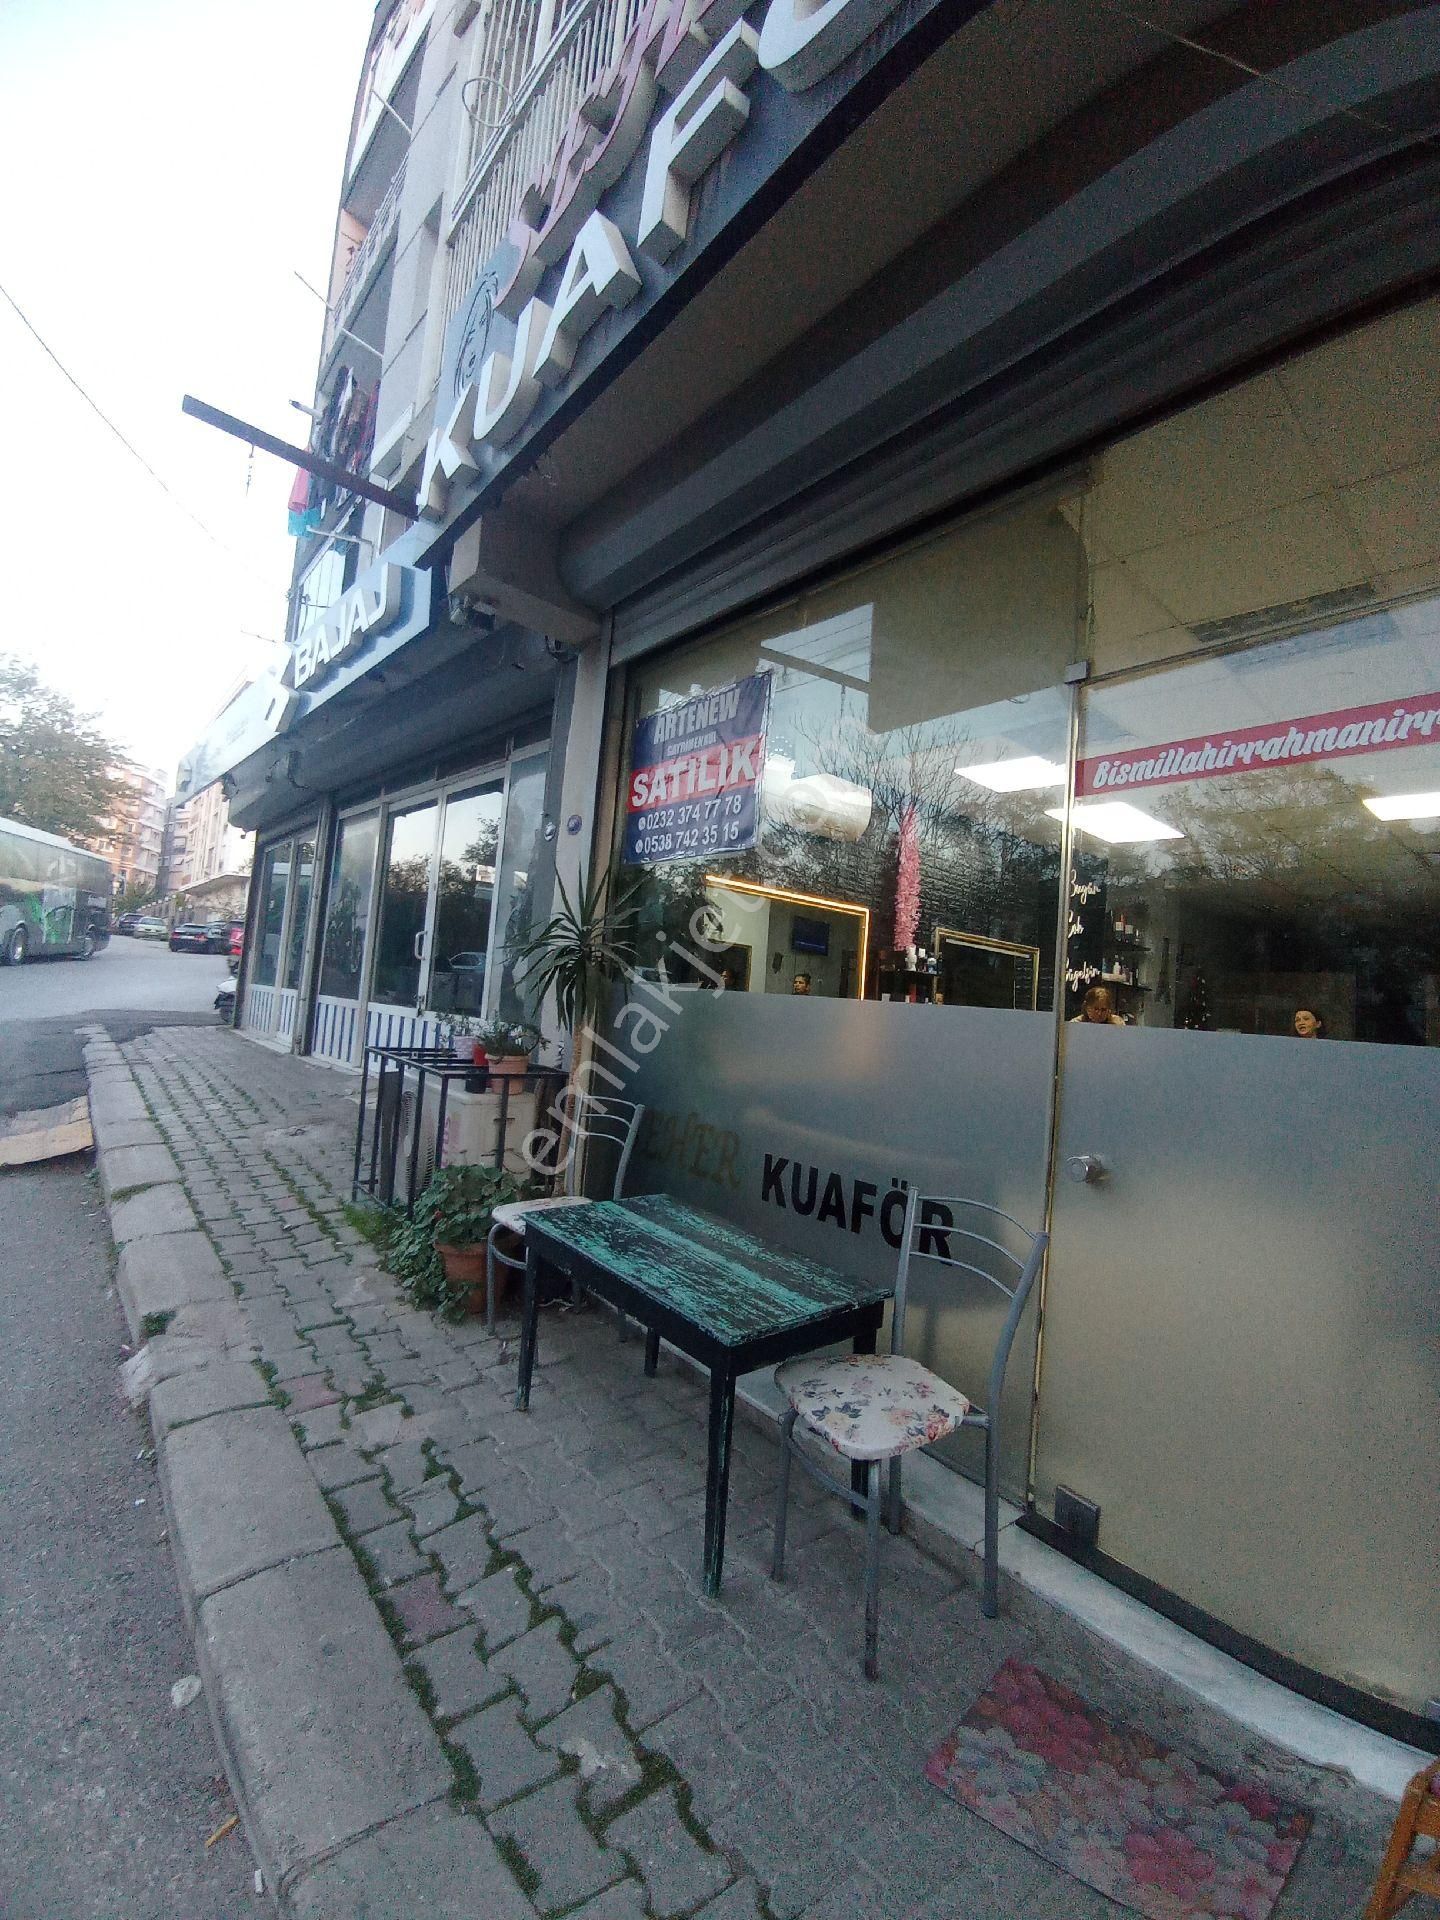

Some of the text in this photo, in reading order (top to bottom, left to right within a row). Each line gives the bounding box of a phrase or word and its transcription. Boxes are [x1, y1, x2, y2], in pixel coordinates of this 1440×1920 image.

[294, 561, 389, 690] BAJAJ
[653, 688, 740, 745] ARTENEW
[644, 821, 740, 854] 0538 742 35 15
[646, 795, 742, 830] 0232 374 77 78
[761, 1153, 954, 1267] KUAFÖR
